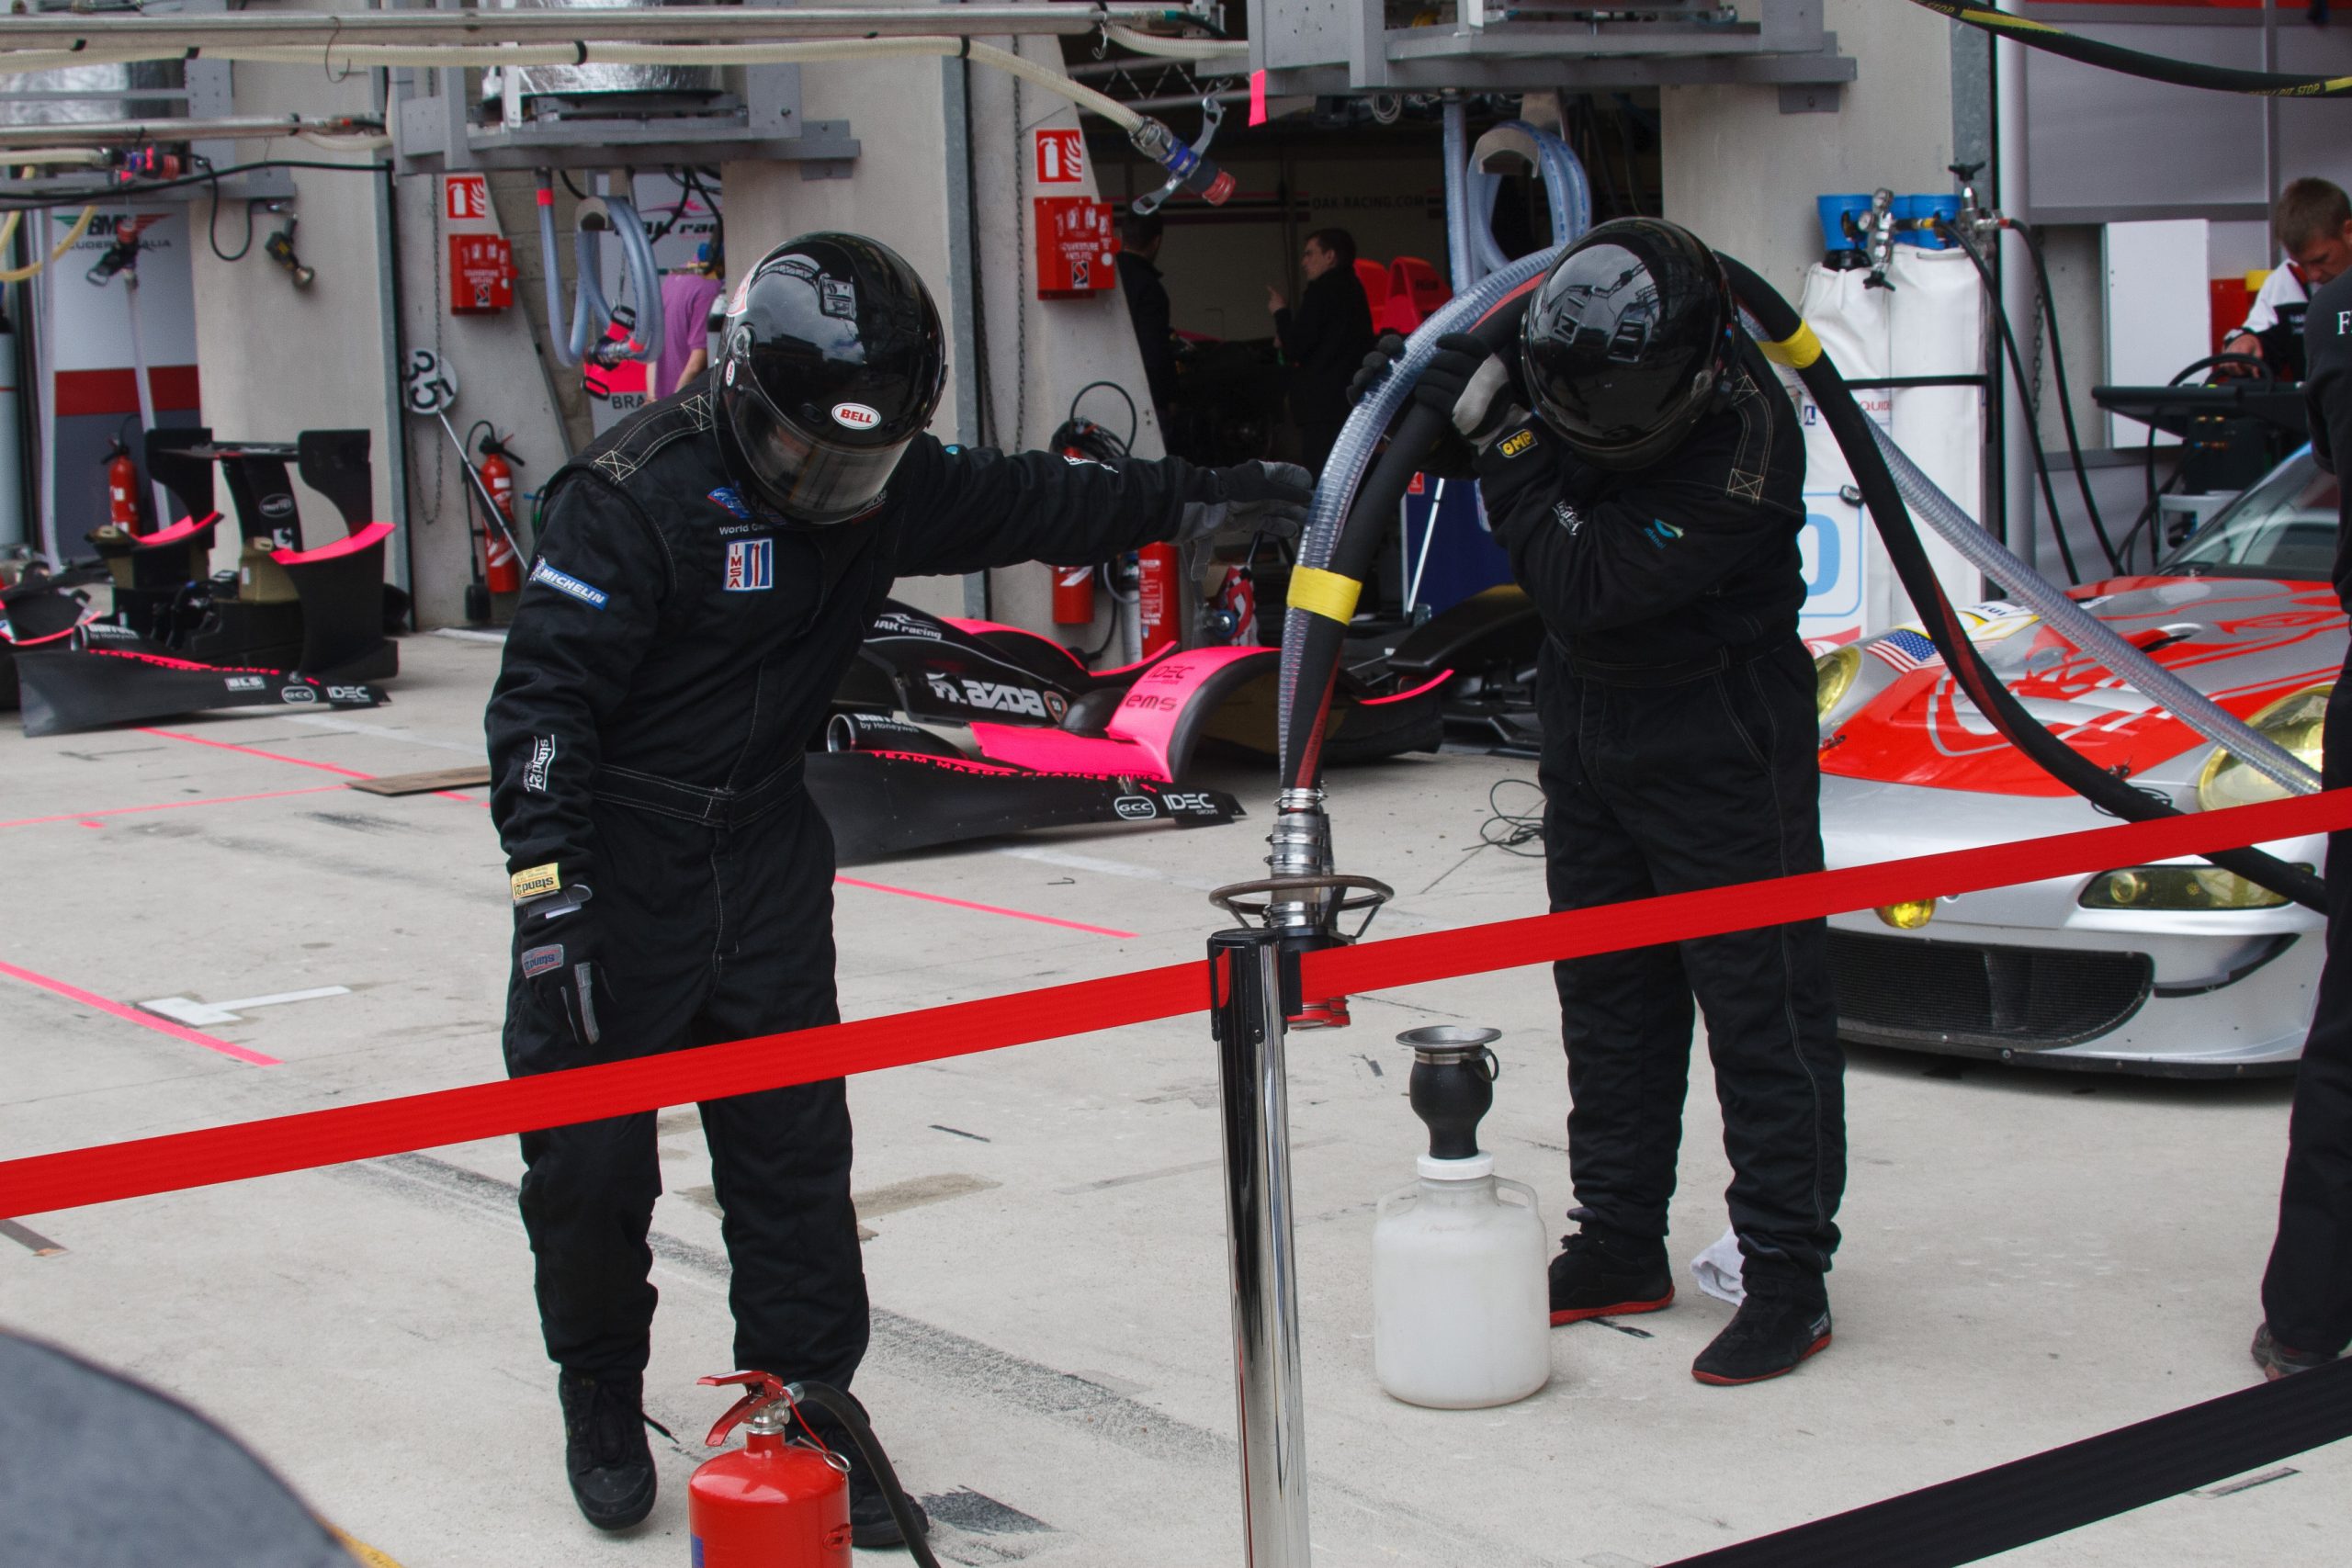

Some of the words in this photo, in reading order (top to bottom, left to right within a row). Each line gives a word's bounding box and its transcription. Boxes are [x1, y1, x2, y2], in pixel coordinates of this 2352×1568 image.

[2297, 83, 2320, 96] STOP
[841, 409, 872, 423] BELL
[1502, 432, 1532, 456] OMP
[719, 524, 749, 536] World
[729, 544, 742, 588] IMSA
[540, 568, 605, 604] MICHELIN
[901, 626, 942, 640] racing
[1148, 666, 1194, 679] IDEC
[228, 677, 260, 687] BLS
[327, 686, 369, 699] IDEC
[1125, 694, 1177, 711] ems
[860, 722, 872, 731] by
[872, 750, 928, 764] TEAM
[936, 761, 1012, 777] MAZDA
[1119, 803, 1151, 812] GCC
[1162, 794, 1215, 810] IDEC
